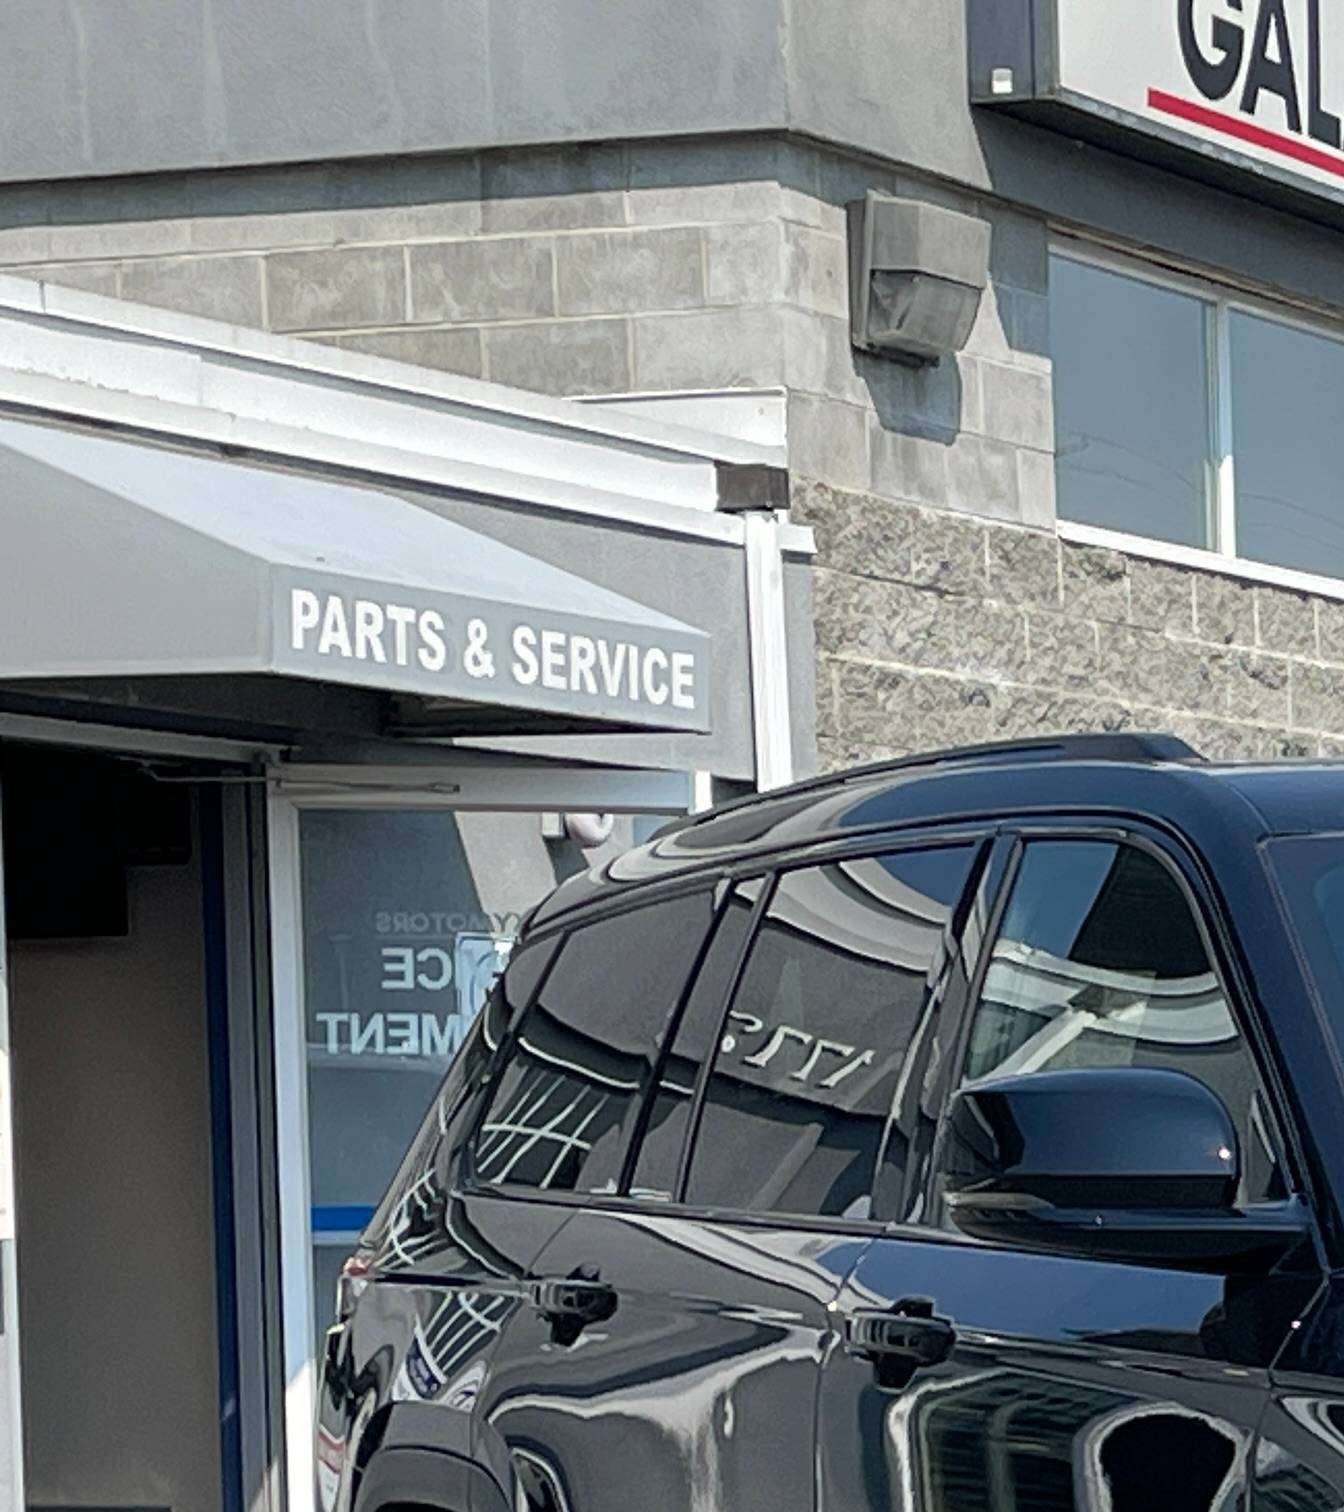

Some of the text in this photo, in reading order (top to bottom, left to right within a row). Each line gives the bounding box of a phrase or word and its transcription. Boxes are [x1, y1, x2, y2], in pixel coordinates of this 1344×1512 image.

[290, 588, 696, 710] PARTS & SERVICE
